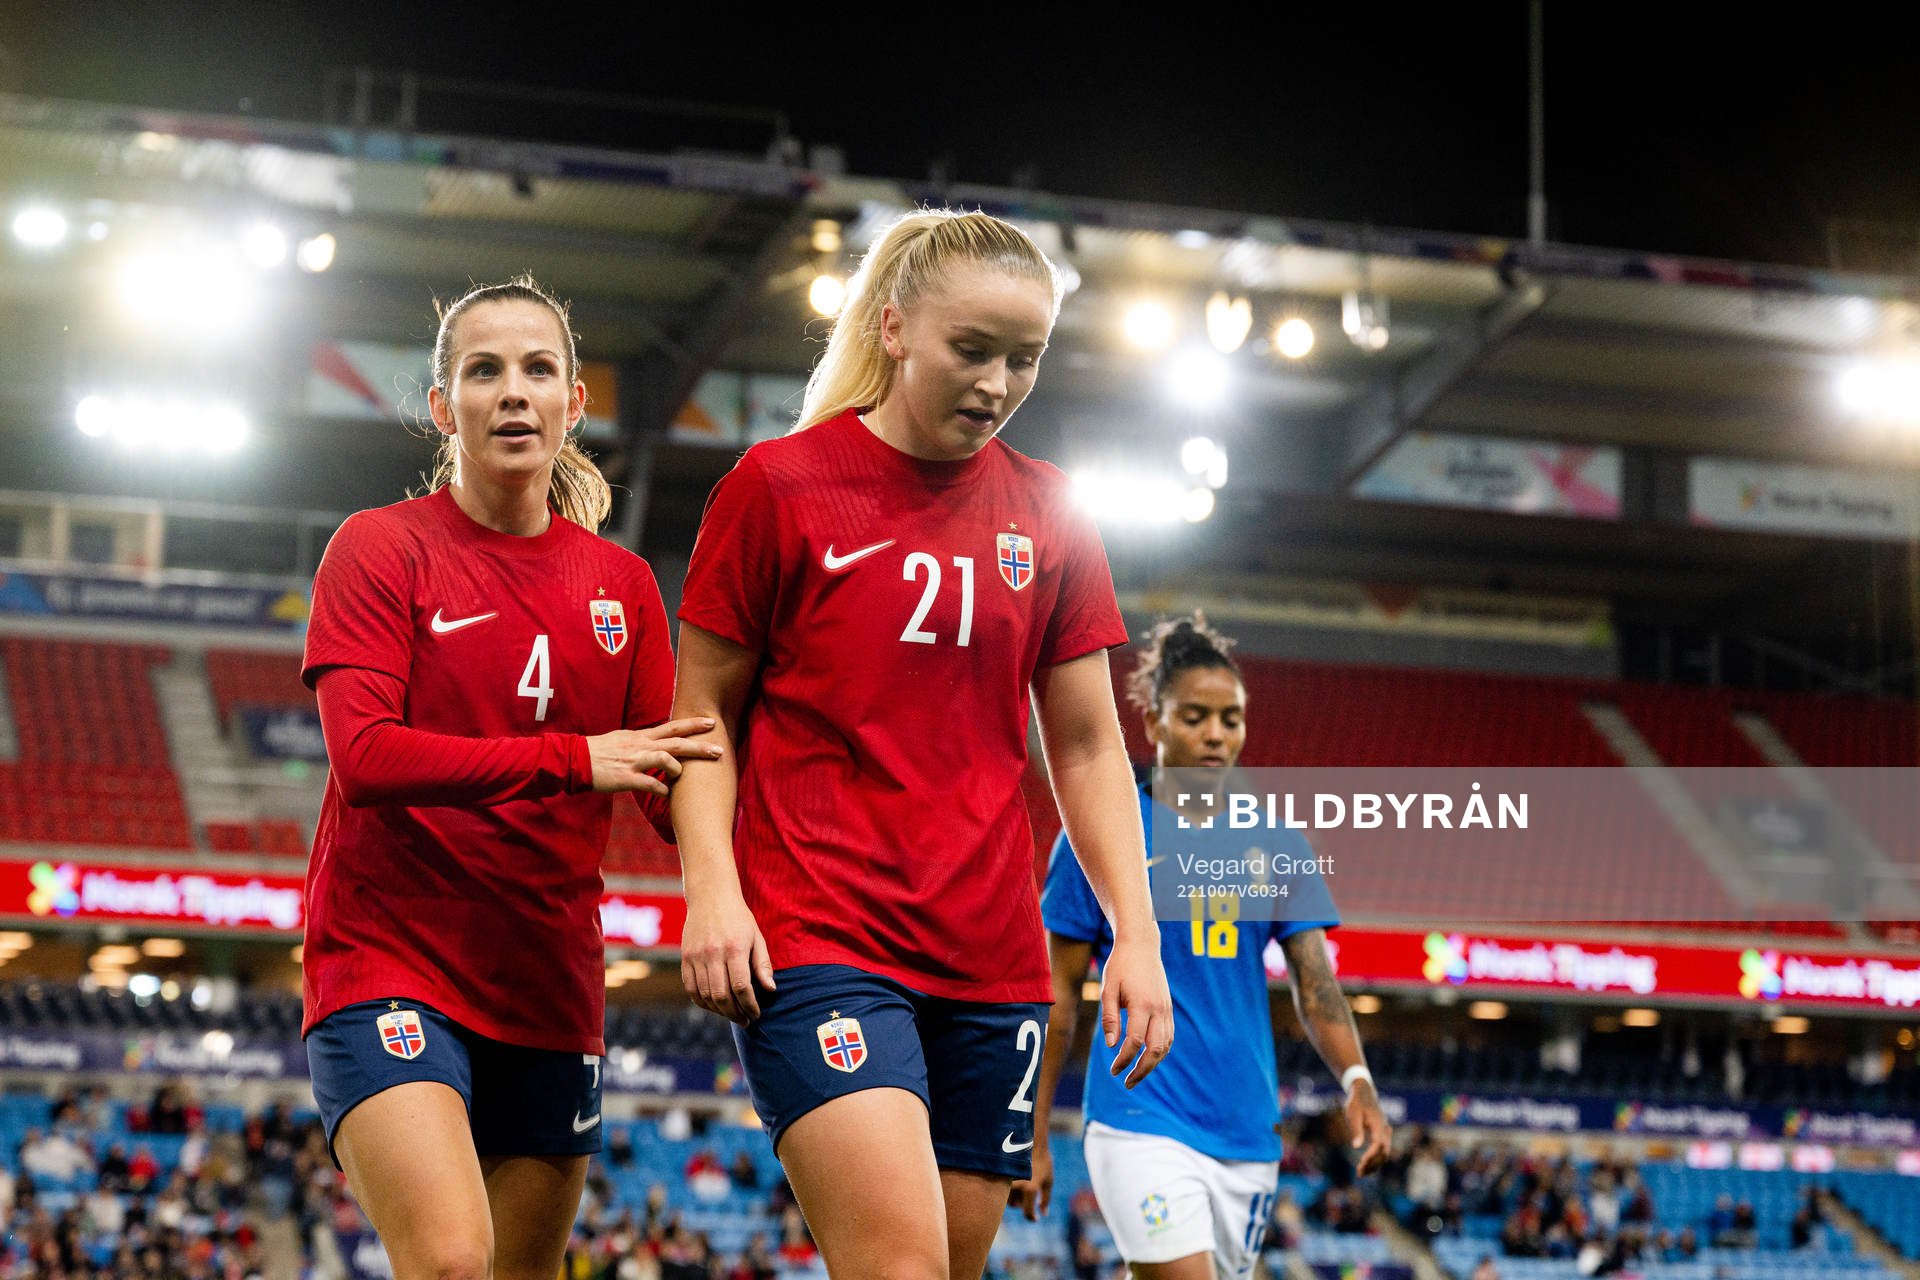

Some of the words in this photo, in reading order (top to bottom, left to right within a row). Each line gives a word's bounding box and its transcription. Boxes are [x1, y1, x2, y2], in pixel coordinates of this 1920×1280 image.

[899, 552, 974, 647] 21
[517, 634, 554, 721] 4
[82, 871, 181, 916] Norsk
[180, 875, 302, 929] Tipping
[1190, 889, 1240, 959] 18
[1469, 940, 1552, 983] Norsk
[1552, 944, 1658, 994] Tipping
[1783, 956, 1865, 999] Norsk
[1008, 1019, 1049, 1113] 2
